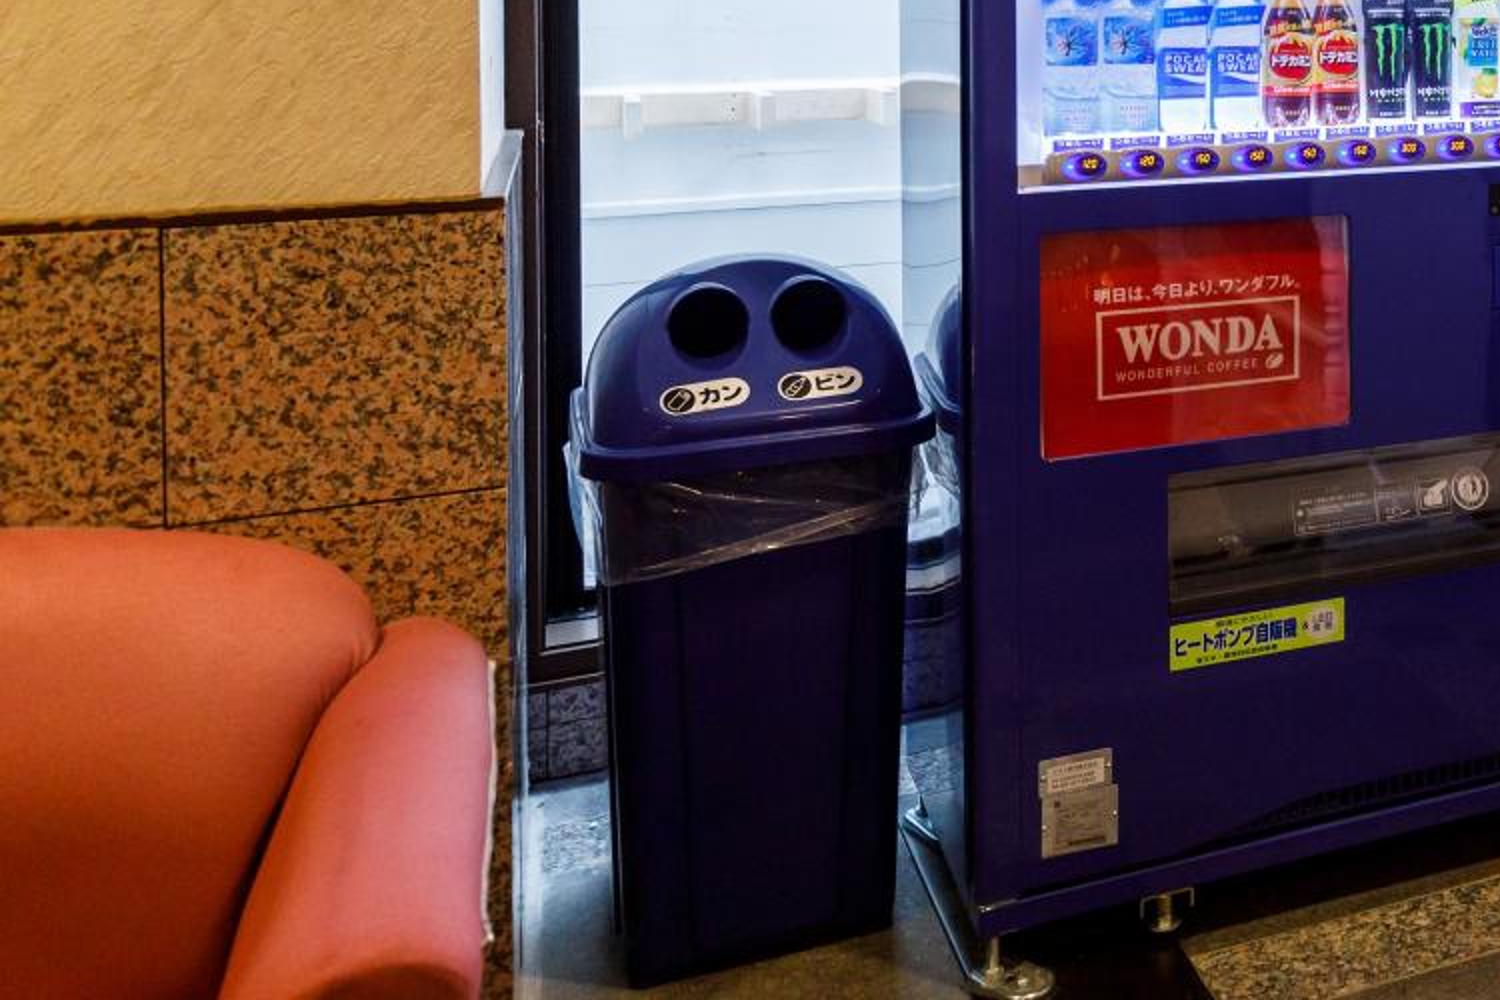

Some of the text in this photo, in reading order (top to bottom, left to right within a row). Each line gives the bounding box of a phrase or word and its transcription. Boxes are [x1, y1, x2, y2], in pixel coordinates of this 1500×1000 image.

[1117, 313, 1283, 364] WONDA
[815, 374, 856, 391] ビン
[1115, 357, 1259, 383] WONDERFUL COFFEE
[699, 382, 742, 405] カン
[1175, 616, 1297, 657] ヒートポンプ自販機
